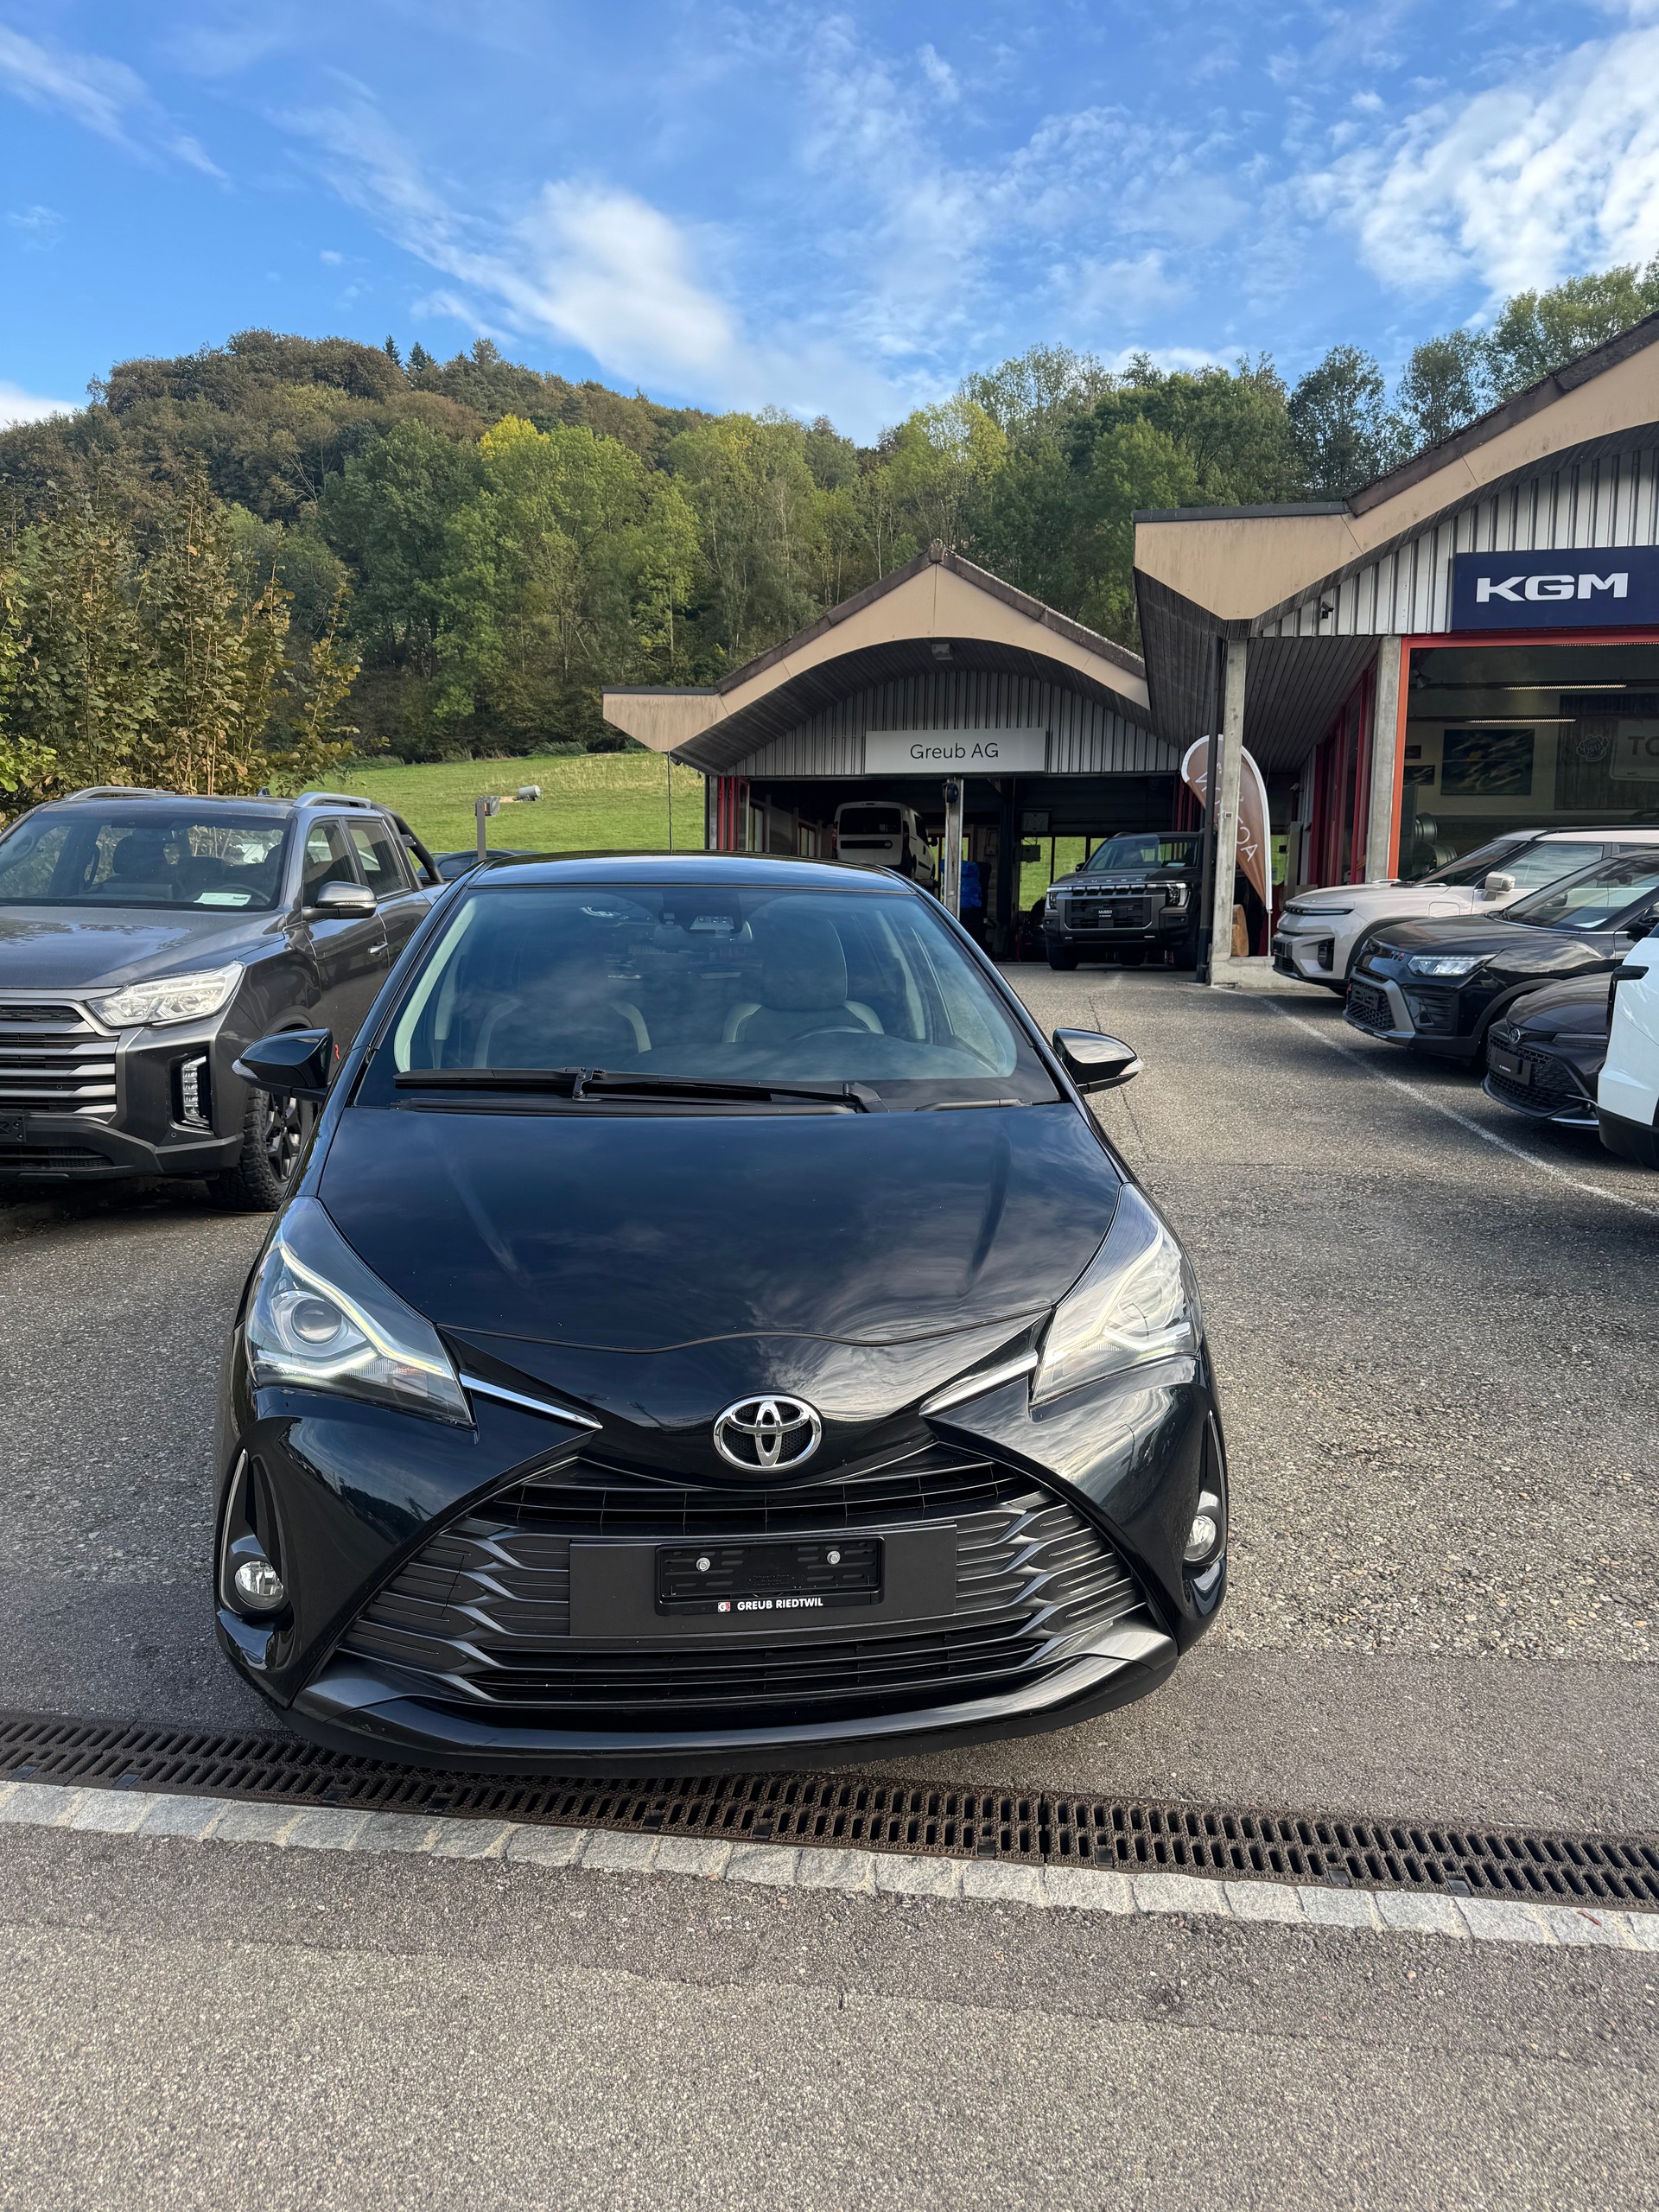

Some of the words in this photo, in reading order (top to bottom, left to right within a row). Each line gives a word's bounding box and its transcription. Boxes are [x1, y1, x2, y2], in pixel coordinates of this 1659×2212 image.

[1476, 572, 1629, 602] KGM
[910, 742, 966, 760] Greub
[970, 742, 999, 758] AG
[737, 1600, 772, 1611] GREUB
[776, 1598, 823, 1608] RIEDTWIL
